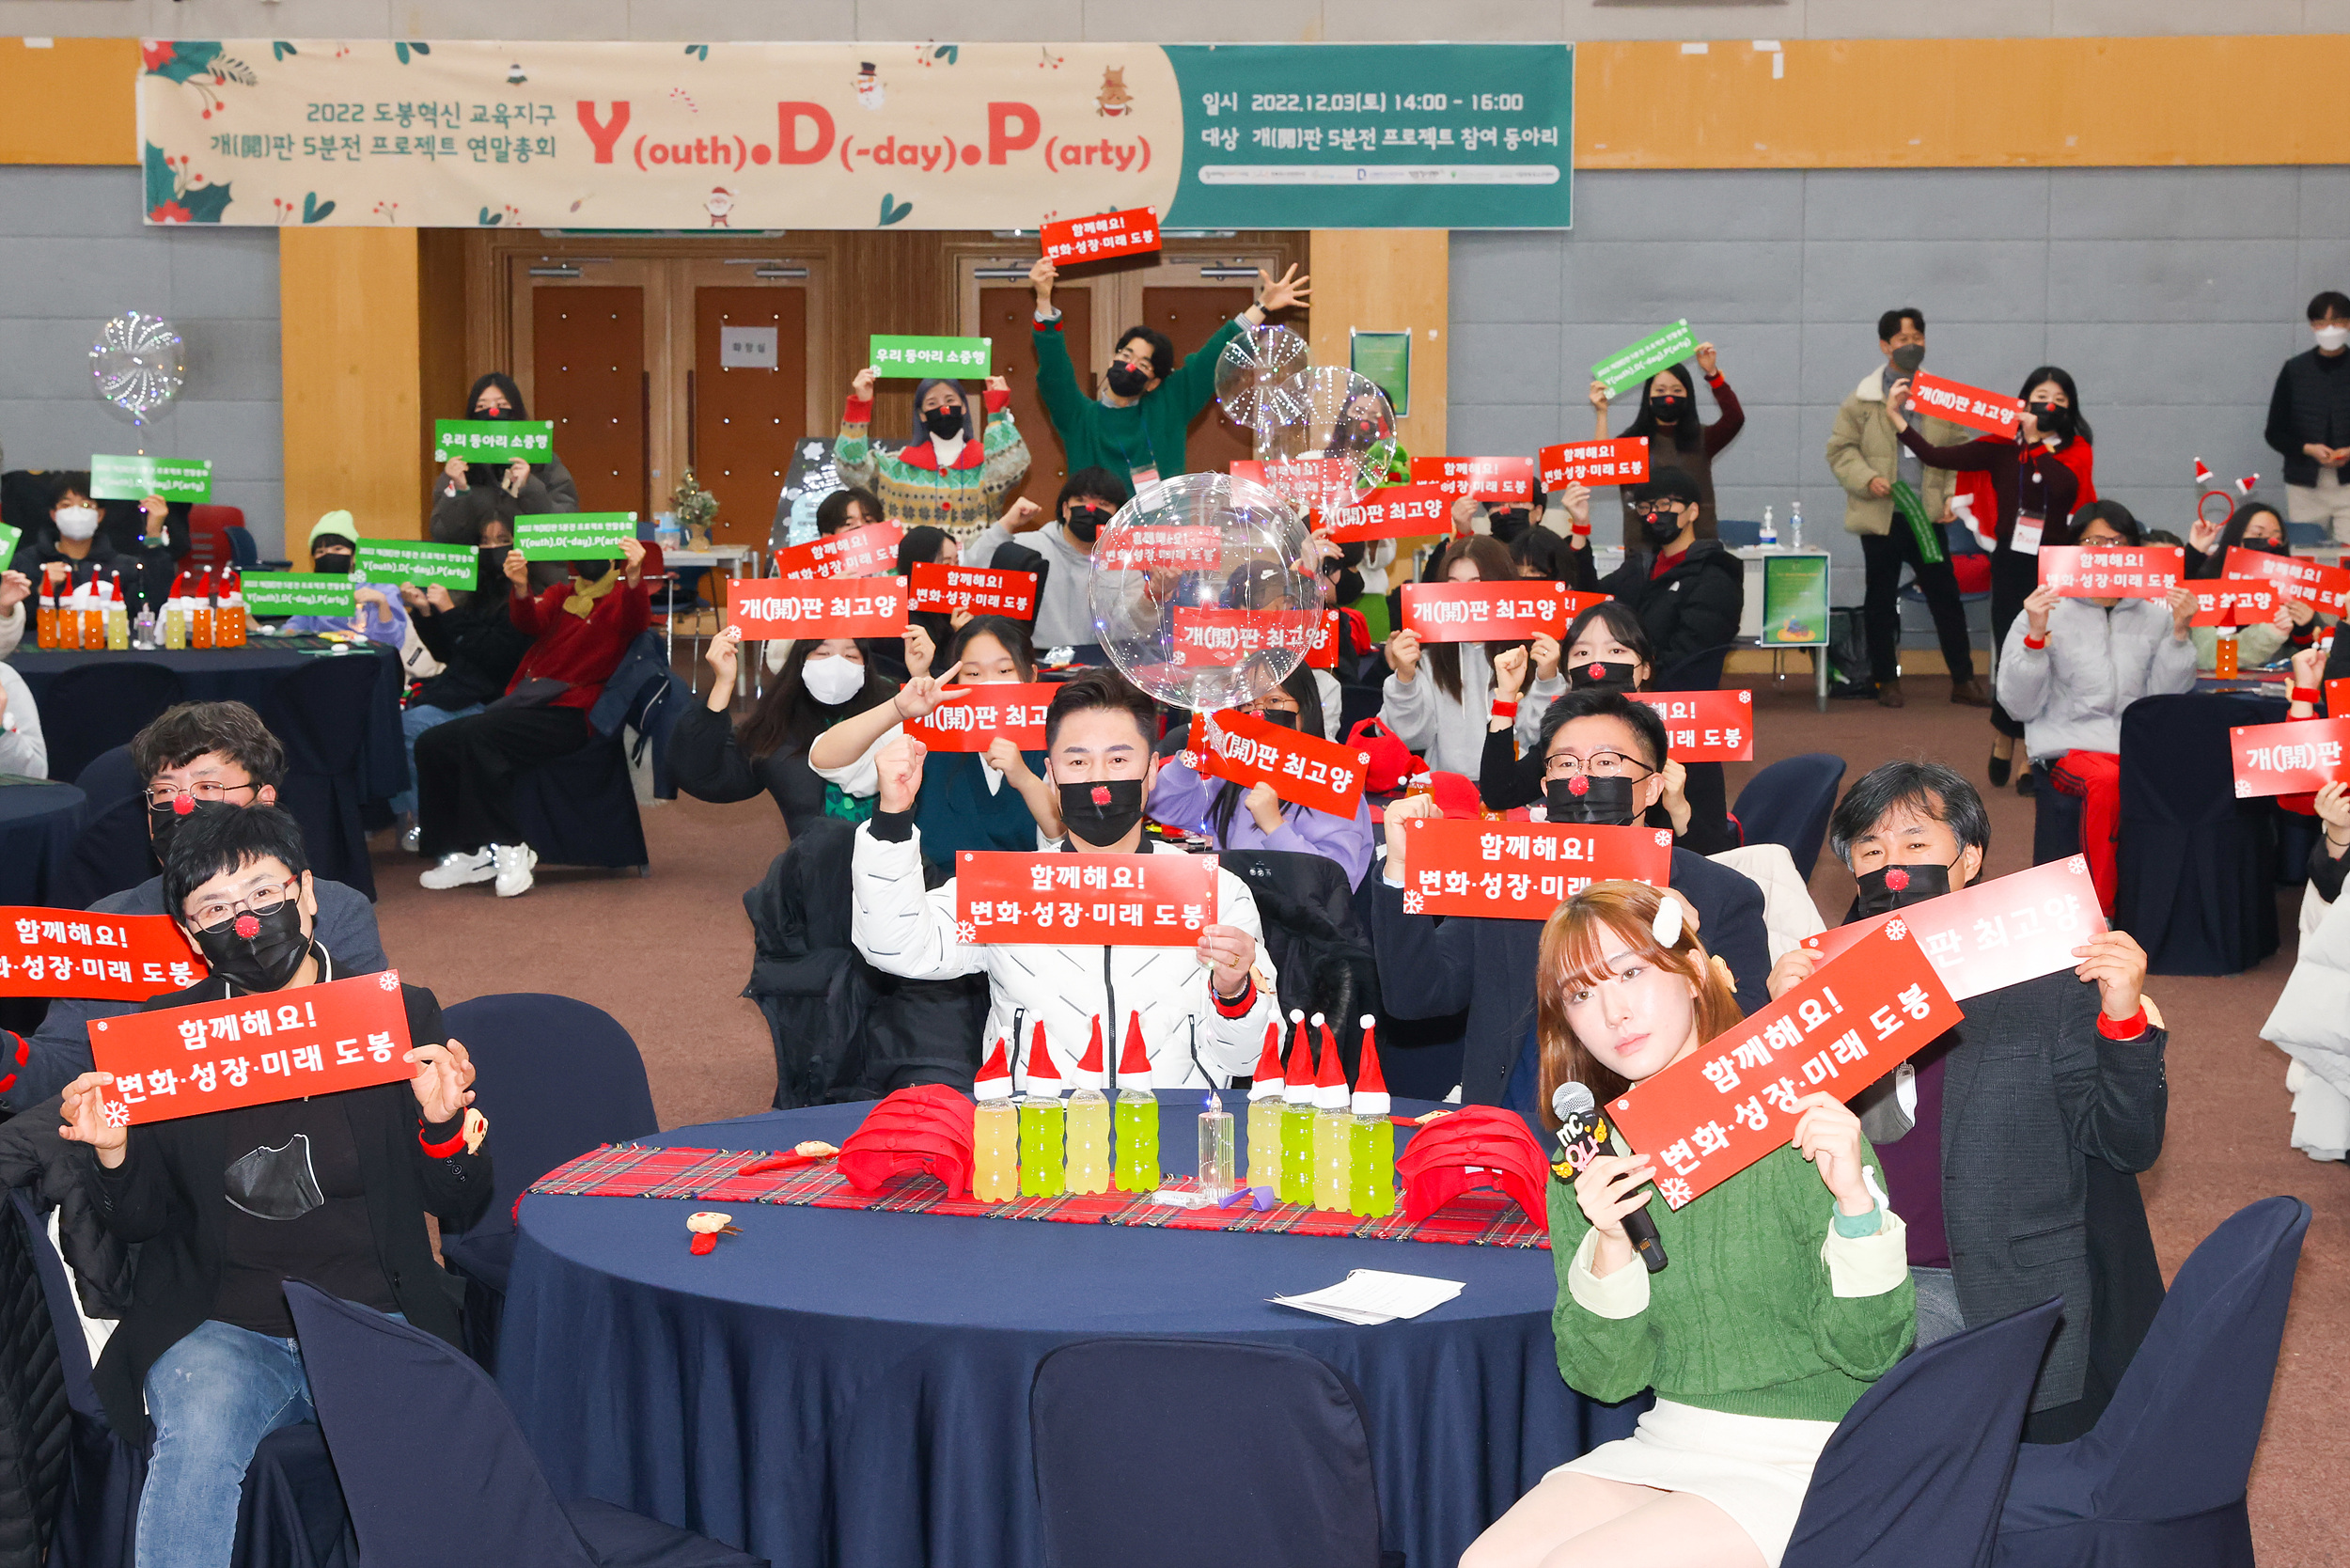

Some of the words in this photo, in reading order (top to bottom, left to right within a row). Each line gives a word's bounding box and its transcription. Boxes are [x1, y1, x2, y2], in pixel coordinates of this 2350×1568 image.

[306, 103, 365, 122] 2022
[373, 102, 462, 129] 도봉혁신
[469, 102, 556, 128] 교육지구
[1202, 92, 1238, 116] 일시
[1251, 92, 1386, 112] 2022.12.03(토)
[1395, 93, 1448, 111] 14:00
[1471, 93, 1524, 111] 16:00
[303, 134, 361, 162] 5분전
[369, 134, 459, 161] 프로젝트
[466, 134, 556, 164] 연말총회
[1201, 127, 1239, 151] 대상
[1328, 127, 1376, 150] 5분전
[1382, 128, 1455, 150] 프로젝트
[1461, 127, 1497, 150] 참여
[1503, 127, 1559, 151] 동아리
[1072, 217, 1126, 238] 함께해요!
[1130, 229, 1154, 244] 도봉
[875, 349, 901, 363] 우리
[904, 349, 944, 364] 동아리
[1971, 400, 2014, 425] 최고양
[441, 432, 467, 447] 우리
[469, 433, 508, 449] 동아리
[1563, 445, 1615, 463] 함께해요!
[1444, 462, 1499, 477] 함께해요!
[1619, 460, 1643, 476] 도봉
[1501, 479, 1527, 494] 도봉
[1389, 498, 1443, 520] 최고양
[810, 534, 869, 560] 함께해요!
[2079, 553, 2144, 569] 함께해요!
[948, 571, 1003, 588] 함께해요!
[2147, 573, 2177, 589] 도봉
[739, 596, 824, 621] 개(開)판
[830, 595, 898, 619] 최고양
[1003, 595, 1027, 611] 도봉
[1412, 599, 1490, 624] 개(開)판
[1496, 598, 1557, 621] 최고양
[1266, 627, 1329, 651] 최고양
[1703, 728, 1743, 749] 도봉
[1200, 730, 1279, 773] (開)판
[1282, 752, 1355, 794] 최고양
[2246, 740, 2343, 773] 개(開)판
[1480, 832, 1595, 863] 함께해요!
[1030, 863, 1145, 891] 함께해요!
[969, 900, 1144, 928] 변화·성장·미래
[1152, 903, 1205, 931] 도봉
[1972, 893, 2082, 951] 최고양
[14, 917, 129, 949] 함께해요!
[142, 961, 194, 987] 도봉
[1868, 981, 1932, 1042] 도봉
[177, 1001, 318, 1052] 함께해요!
[1701, 985, 1845, 1095] 함께해요!
[115, 1043, 324, 1105] 변화·성장·미래
[335, 1030, 396, 1067] 도봉
